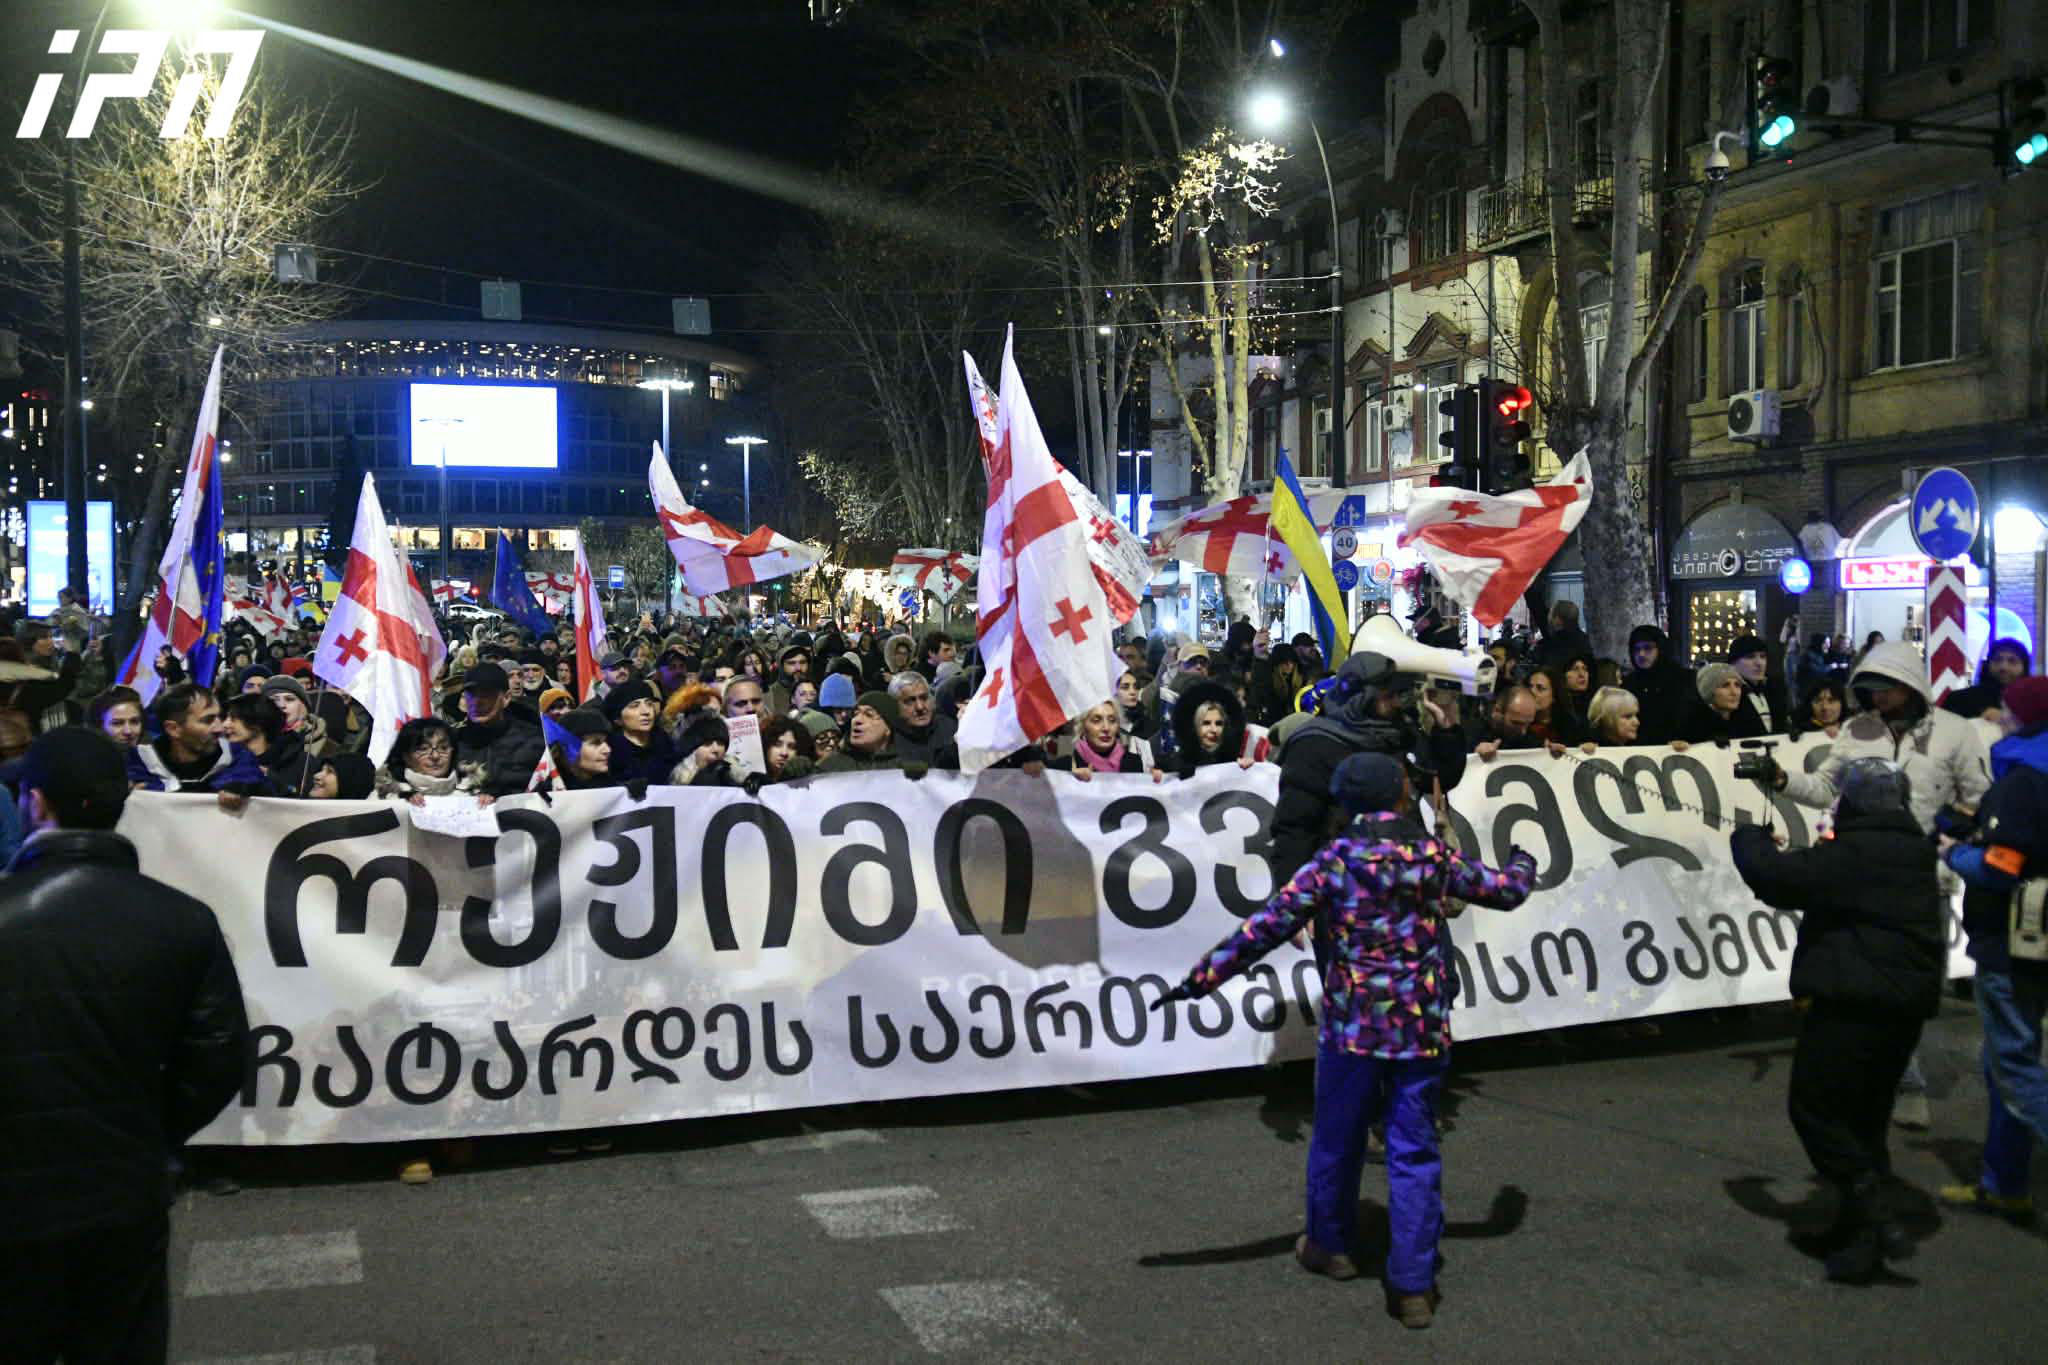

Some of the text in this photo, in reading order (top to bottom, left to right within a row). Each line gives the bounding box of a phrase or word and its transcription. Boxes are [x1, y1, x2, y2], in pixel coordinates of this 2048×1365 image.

[1337, 537, 1353, 549] 40
[1743, 548, 1795, 558] UNDER
[264, 797, 1033, 968] რეჟიმი
[240, 1001, 814, 1109] ჩატარდეს
